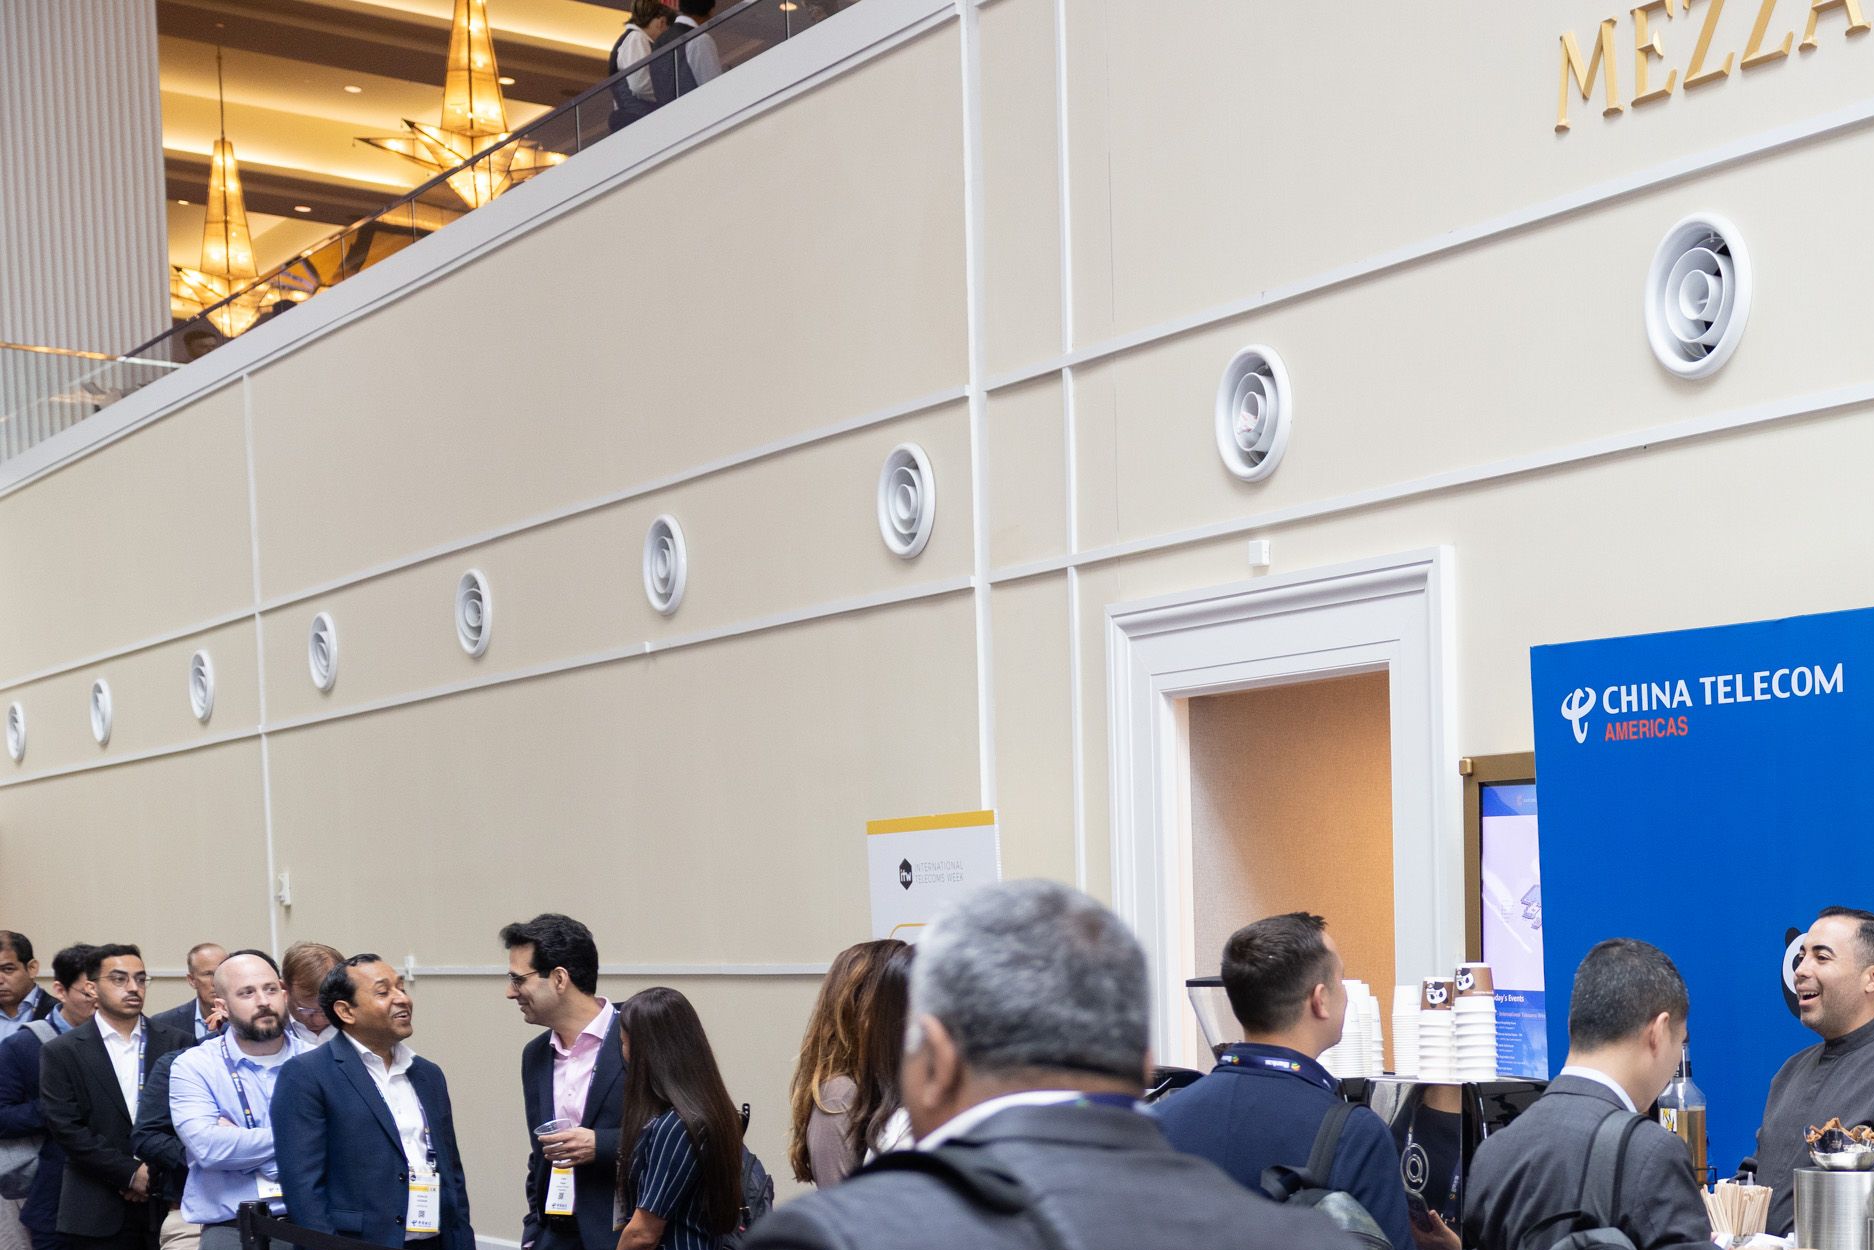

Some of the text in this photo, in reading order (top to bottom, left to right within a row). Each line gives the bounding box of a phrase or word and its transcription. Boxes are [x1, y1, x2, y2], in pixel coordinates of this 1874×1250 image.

[1602, 663, 1844, 715] CHINA TELECOM
[1604, 716, 1689, 742] AMERICAS
[1495, 994, 1525, 1003] day's Events
